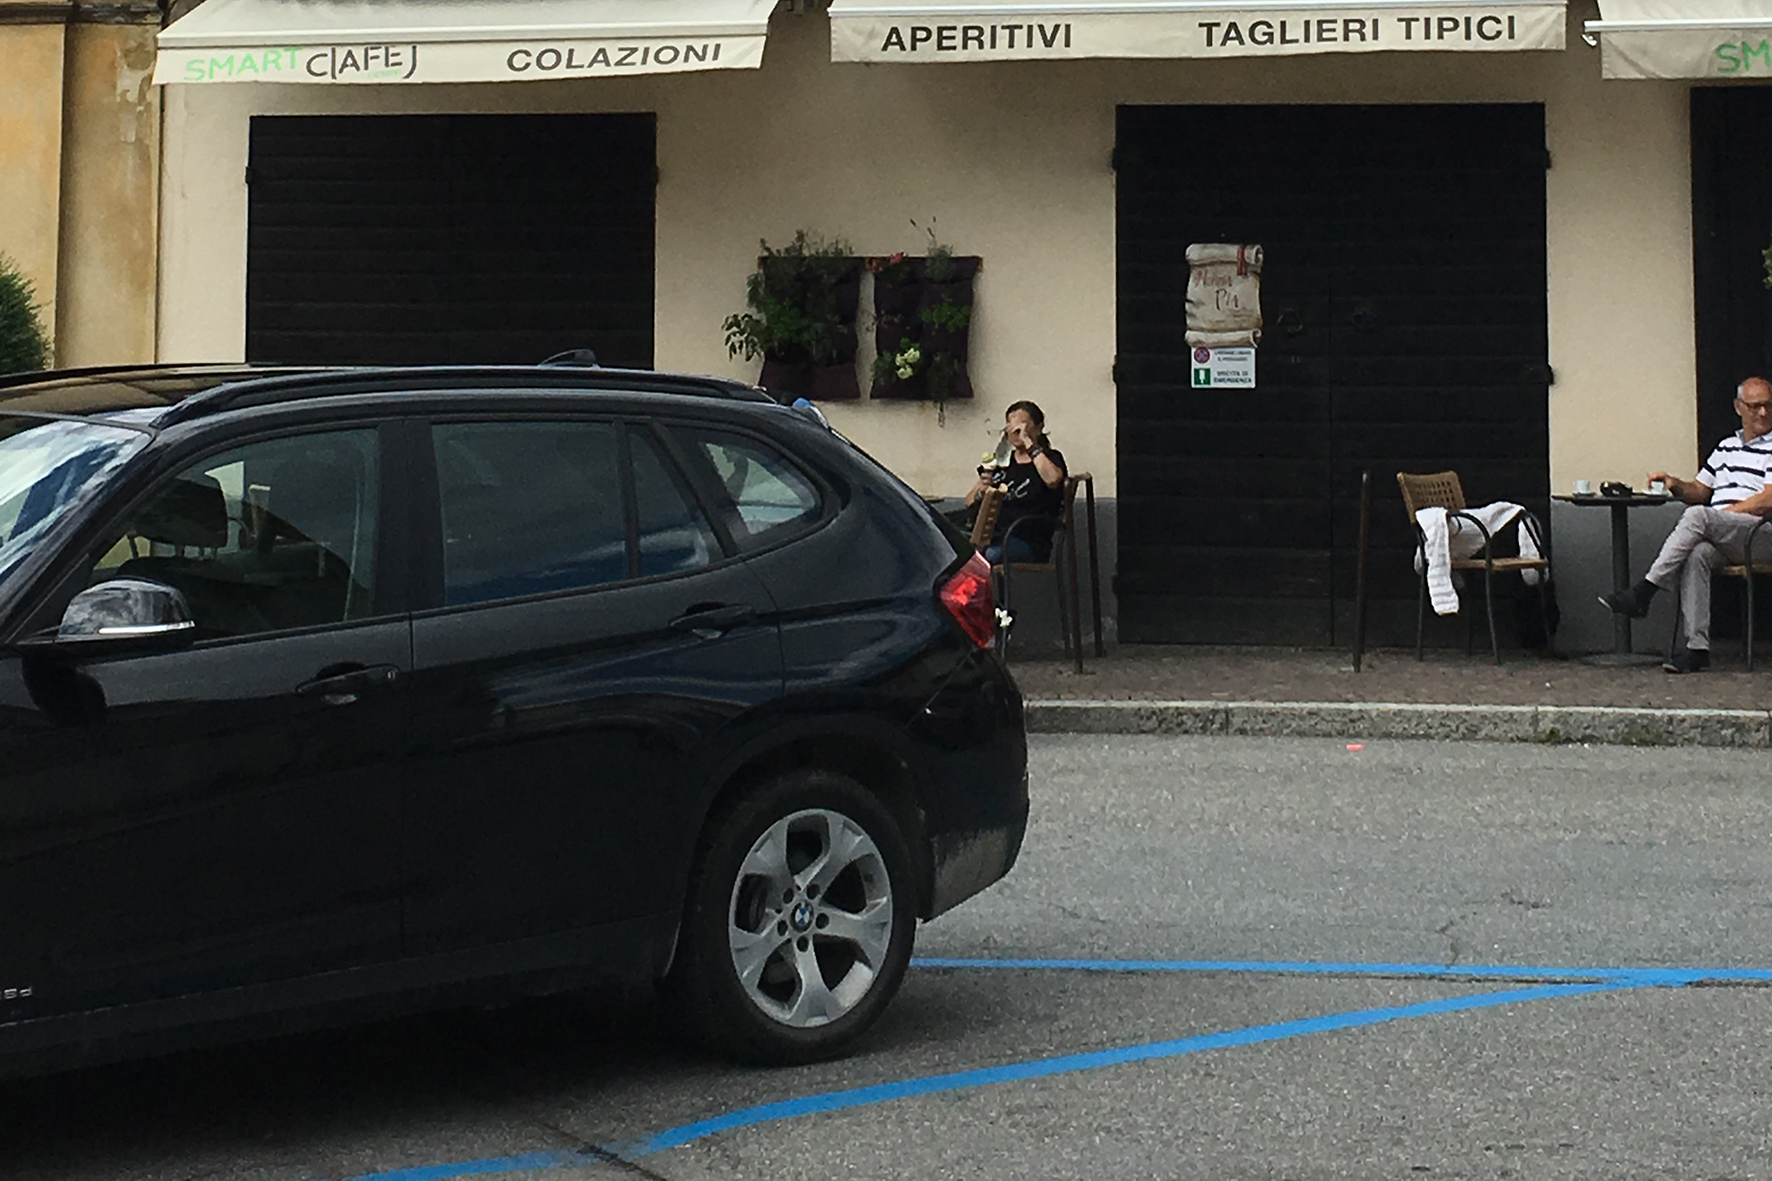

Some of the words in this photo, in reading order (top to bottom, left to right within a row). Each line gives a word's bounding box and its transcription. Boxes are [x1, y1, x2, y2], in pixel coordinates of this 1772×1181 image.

[880, 23, 1072, 52] APERITIVI
[1198, 17, 1380, 47] TAGLIERI
[1396, 14, 1516, 42] TIPICI
[183, 46, 304, 82] SMART
[506, 43, 722, 72] COLAZIONI
